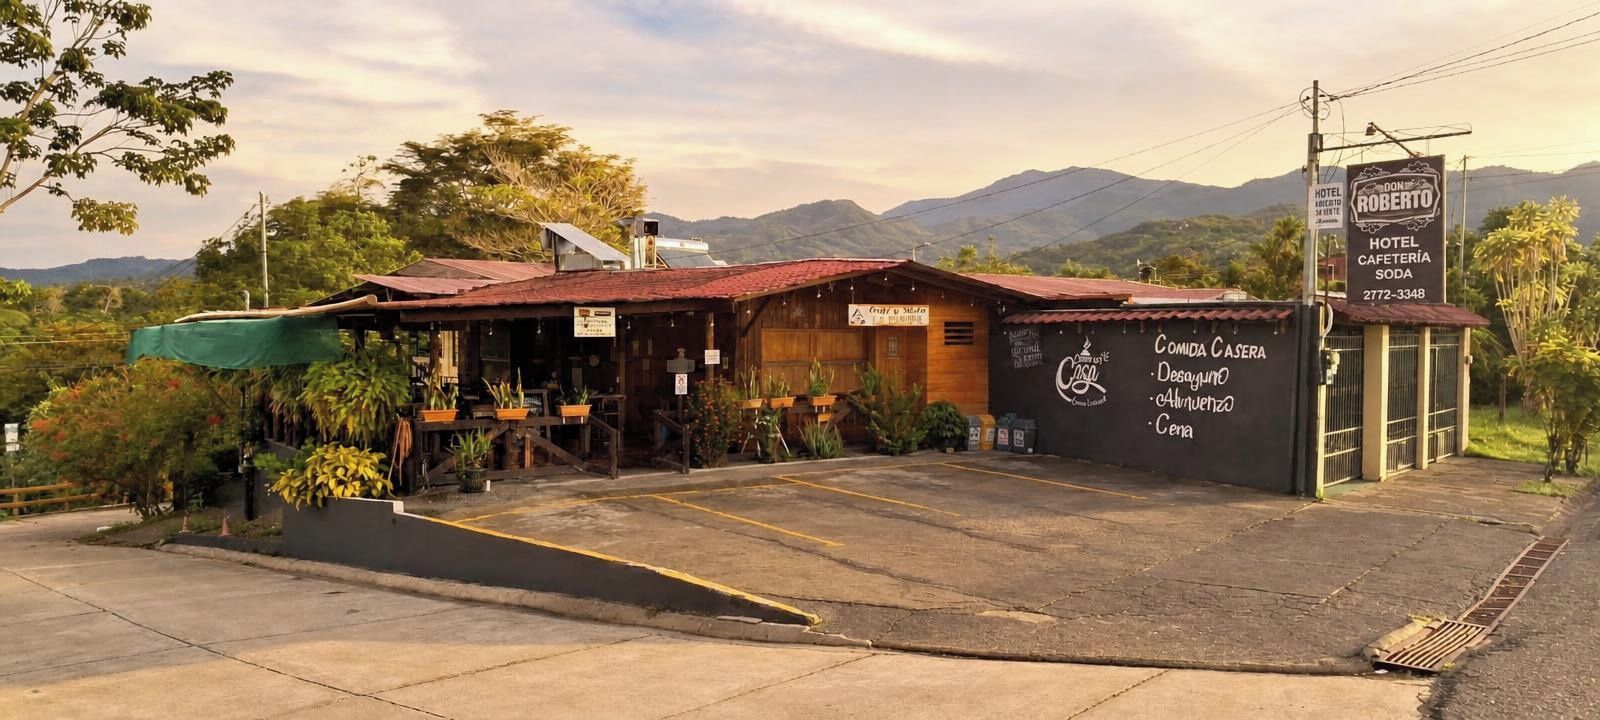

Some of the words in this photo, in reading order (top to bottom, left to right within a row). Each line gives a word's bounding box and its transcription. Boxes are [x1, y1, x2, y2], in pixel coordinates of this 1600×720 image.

[1315, 187, 1342, 198] HOTEL
[1384, 181, 1404, 192] DON
[1357, 189, 1433, 213] ROBERTO
[1369, 236, 1419, 250] HOTEL
[1357, 250, 1432, 266] CAFETERÍA
[1375, 268, 1413, 280] SODA
[1363, 288, 1426, 300] 2772-3348
[1155, 413, 1193, 439] Cena
